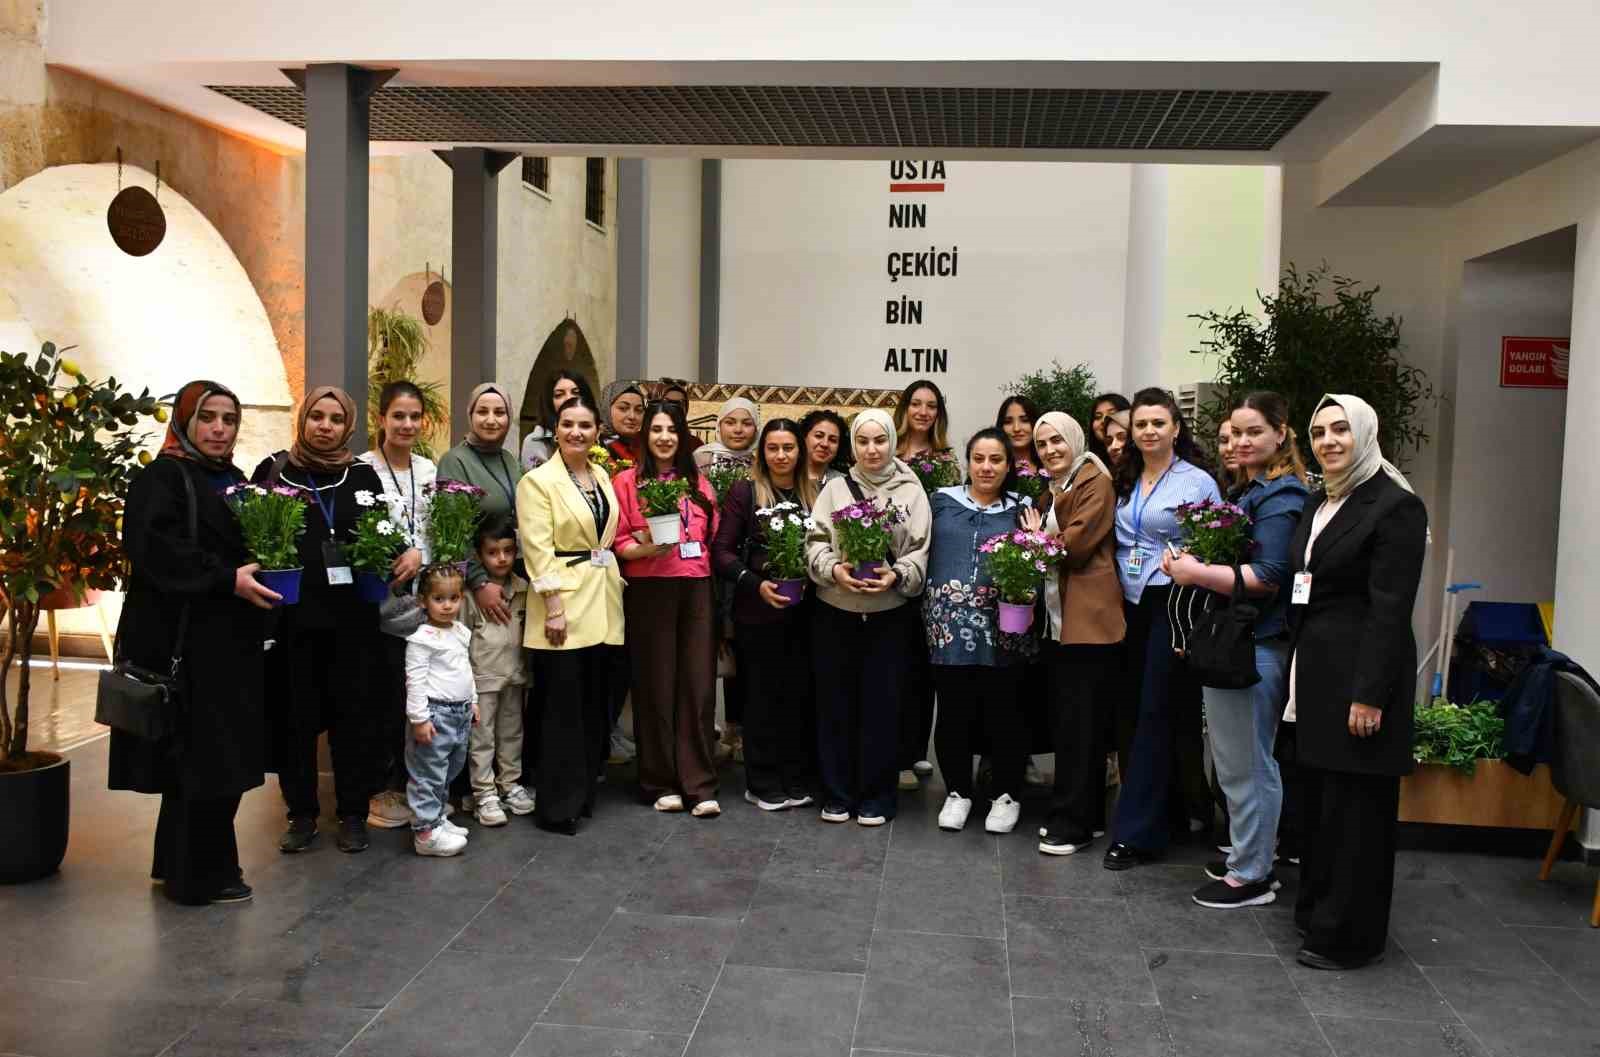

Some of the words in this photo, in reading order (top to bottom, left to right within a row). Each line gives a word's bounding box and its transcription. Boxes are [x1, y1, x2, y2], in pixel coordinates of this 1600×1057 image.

[889, 204, 927, 228] NIN
[887, 246, 959, 282] ÇEKİCİ
[886, 295, 923, 325] BİN
[884, 348, 948, 373] ALTIN
[1509, 364, 1545, 374] DOLABI
